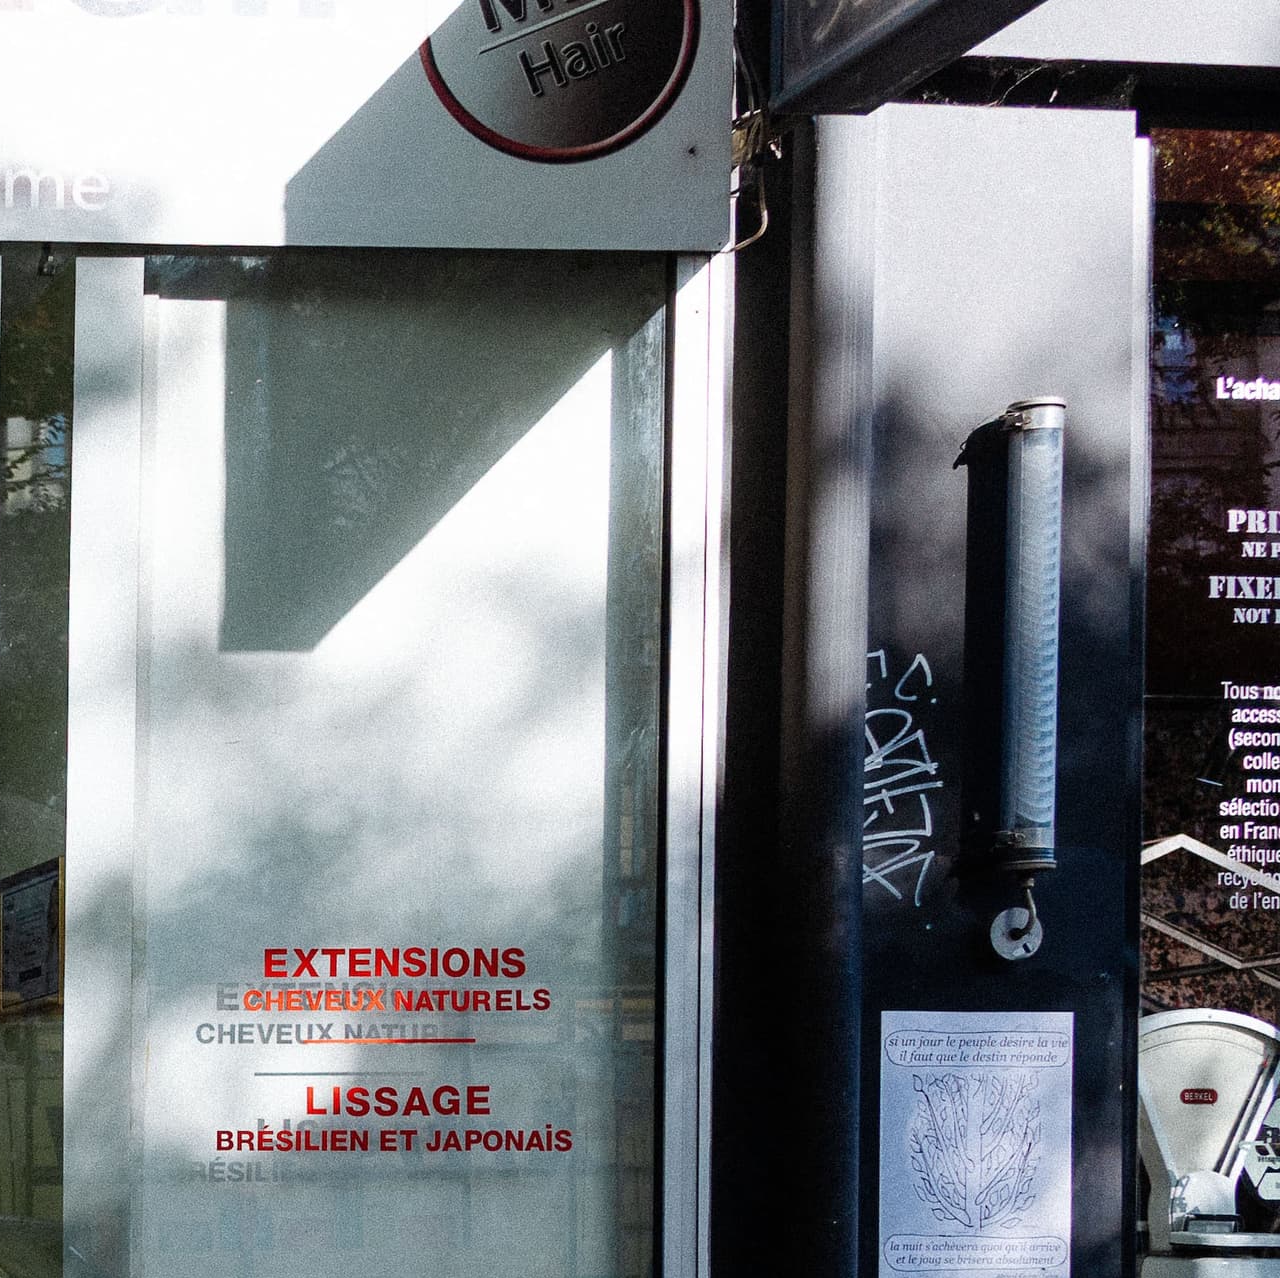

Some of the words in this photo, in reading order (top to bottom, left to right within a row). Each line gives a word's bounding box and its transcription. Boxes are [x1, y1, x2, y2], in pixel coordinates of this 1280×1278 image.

[517, 22, 626, 96] Hair
[1241, 541, 1267, 558] NE
[1233, 607, 1271, 624] NOT
[1220, 681, 1259, 700] Tous
[1220, 824, 1240, 840] en
[1229, 891, 1248, 910] de
[263, 947, 526, 979] EXTENSIONS
[243, 989, 386, 1012] CHEVEUX
[395, 989, 551, 1012] NATURELS
[888, 1036, 899, 1047] si
[901, 1038, 916, 1047] un
[918, 1036, 944, 1049] jour
[946, 1036, 956, 1047] le
[958, 1036, 997, 1049] peuple
[999, 1036, 1034, 1048] désire
[1036, 1036, 1049, 1048] la
[1051, 1037, 1068, 1048] vie
[908, 1050, 933, 1063] faut
[935, 1053, 958, 1064] que
[959, 1051, 970, 1062] le
[972, 1051, 1007, 1062] destin
[1009, 1052, 1058, 1064] réponde
[306, 1086, 491, 1117] LISSAGE
[216, 1125, 369, 1152] BRÉSILIEN
[379, 1129, 418, 1152] ET
[890, 1241, 900, 1251] la
[902, 1242, 923, 1251] nuit
[895, 1255, 905, 1264] et
[907, 1255, 918, 1264] le
[944, 1257, 954, 1265] se
[957, 1255, 992, 1265] brisera
[995, 1255, 1054, 1265] absolument
